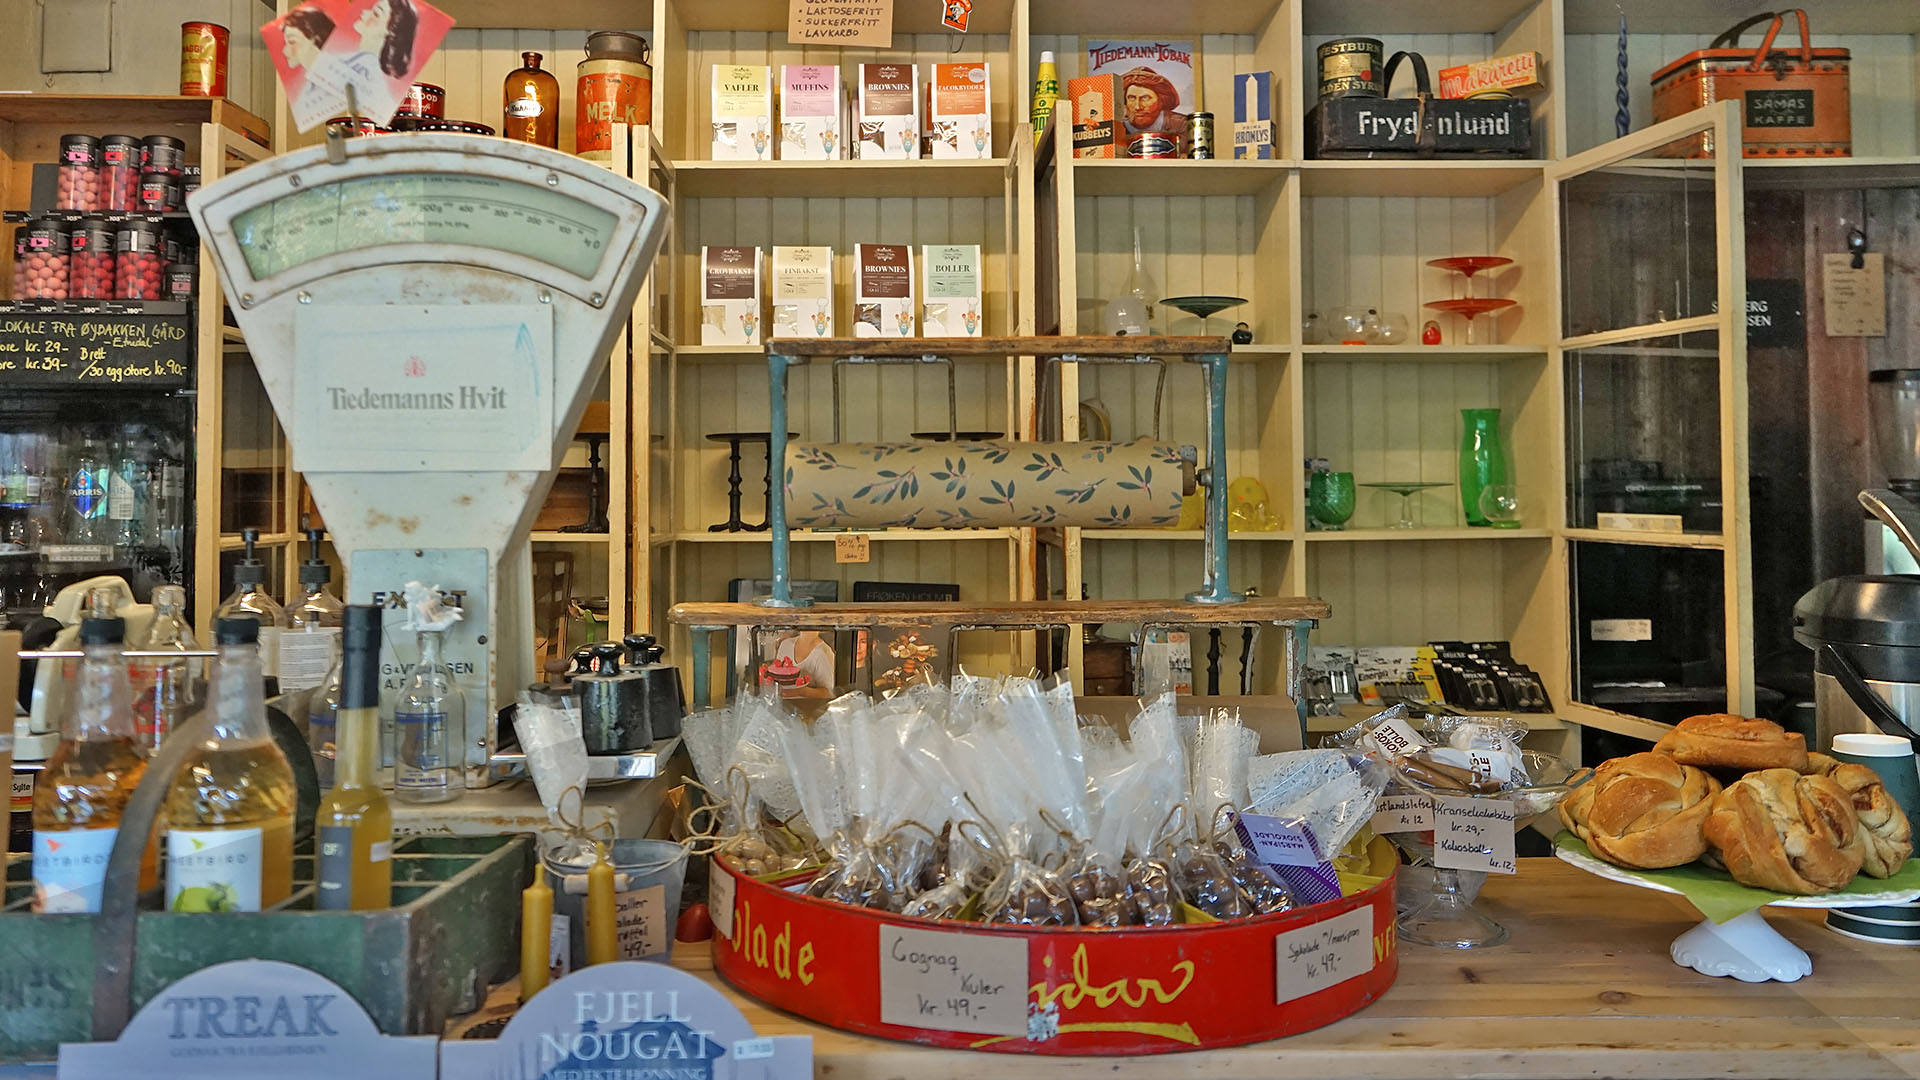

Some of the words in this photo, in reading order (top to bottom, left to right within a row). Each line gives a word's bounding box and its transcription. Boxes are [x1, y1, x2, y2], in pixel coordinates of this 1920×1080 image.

[805, 29, 859, 38] LAVKARBO
[724, 84, 759, 92] VAFLER
[791, 83, 829, 91] MUFFINS
[868, 83, 910, 91] BROWNIES
[938, 84, 985, 92] TACOKRYDDER
[1754, 99, 1806, 109] SAMAS
[586, 101, 638, 123] MELK
[1358, 111, 1510, 141] Frydnlund
[865, 265, 906, 273] BROWNIES
[935, 264, 970, 273] BOLLER
[51, 321, 77, 337] FRA
[152, 322, 186, 340] GÅRD
[80, 346, 107, 361] Brett
[106, 366, 123, 382] egg
[326, 387, 454, 410] Tiedemanns
[458, 385, 508, 410] Hvit
[12, 783, 31, 792] Sylte
[1414, 815, 1424, 824] 12
[892, 936, 960, 975] Cognaq
[960, 973, 1005, 995] Kuler
[573, 990, 692, 1024] FJELL
[947, 998, 987, 1020] 49,-
[162, 994, 339, 1040] TREAK
[538, 1030, 716, 1061] NOUGAT
